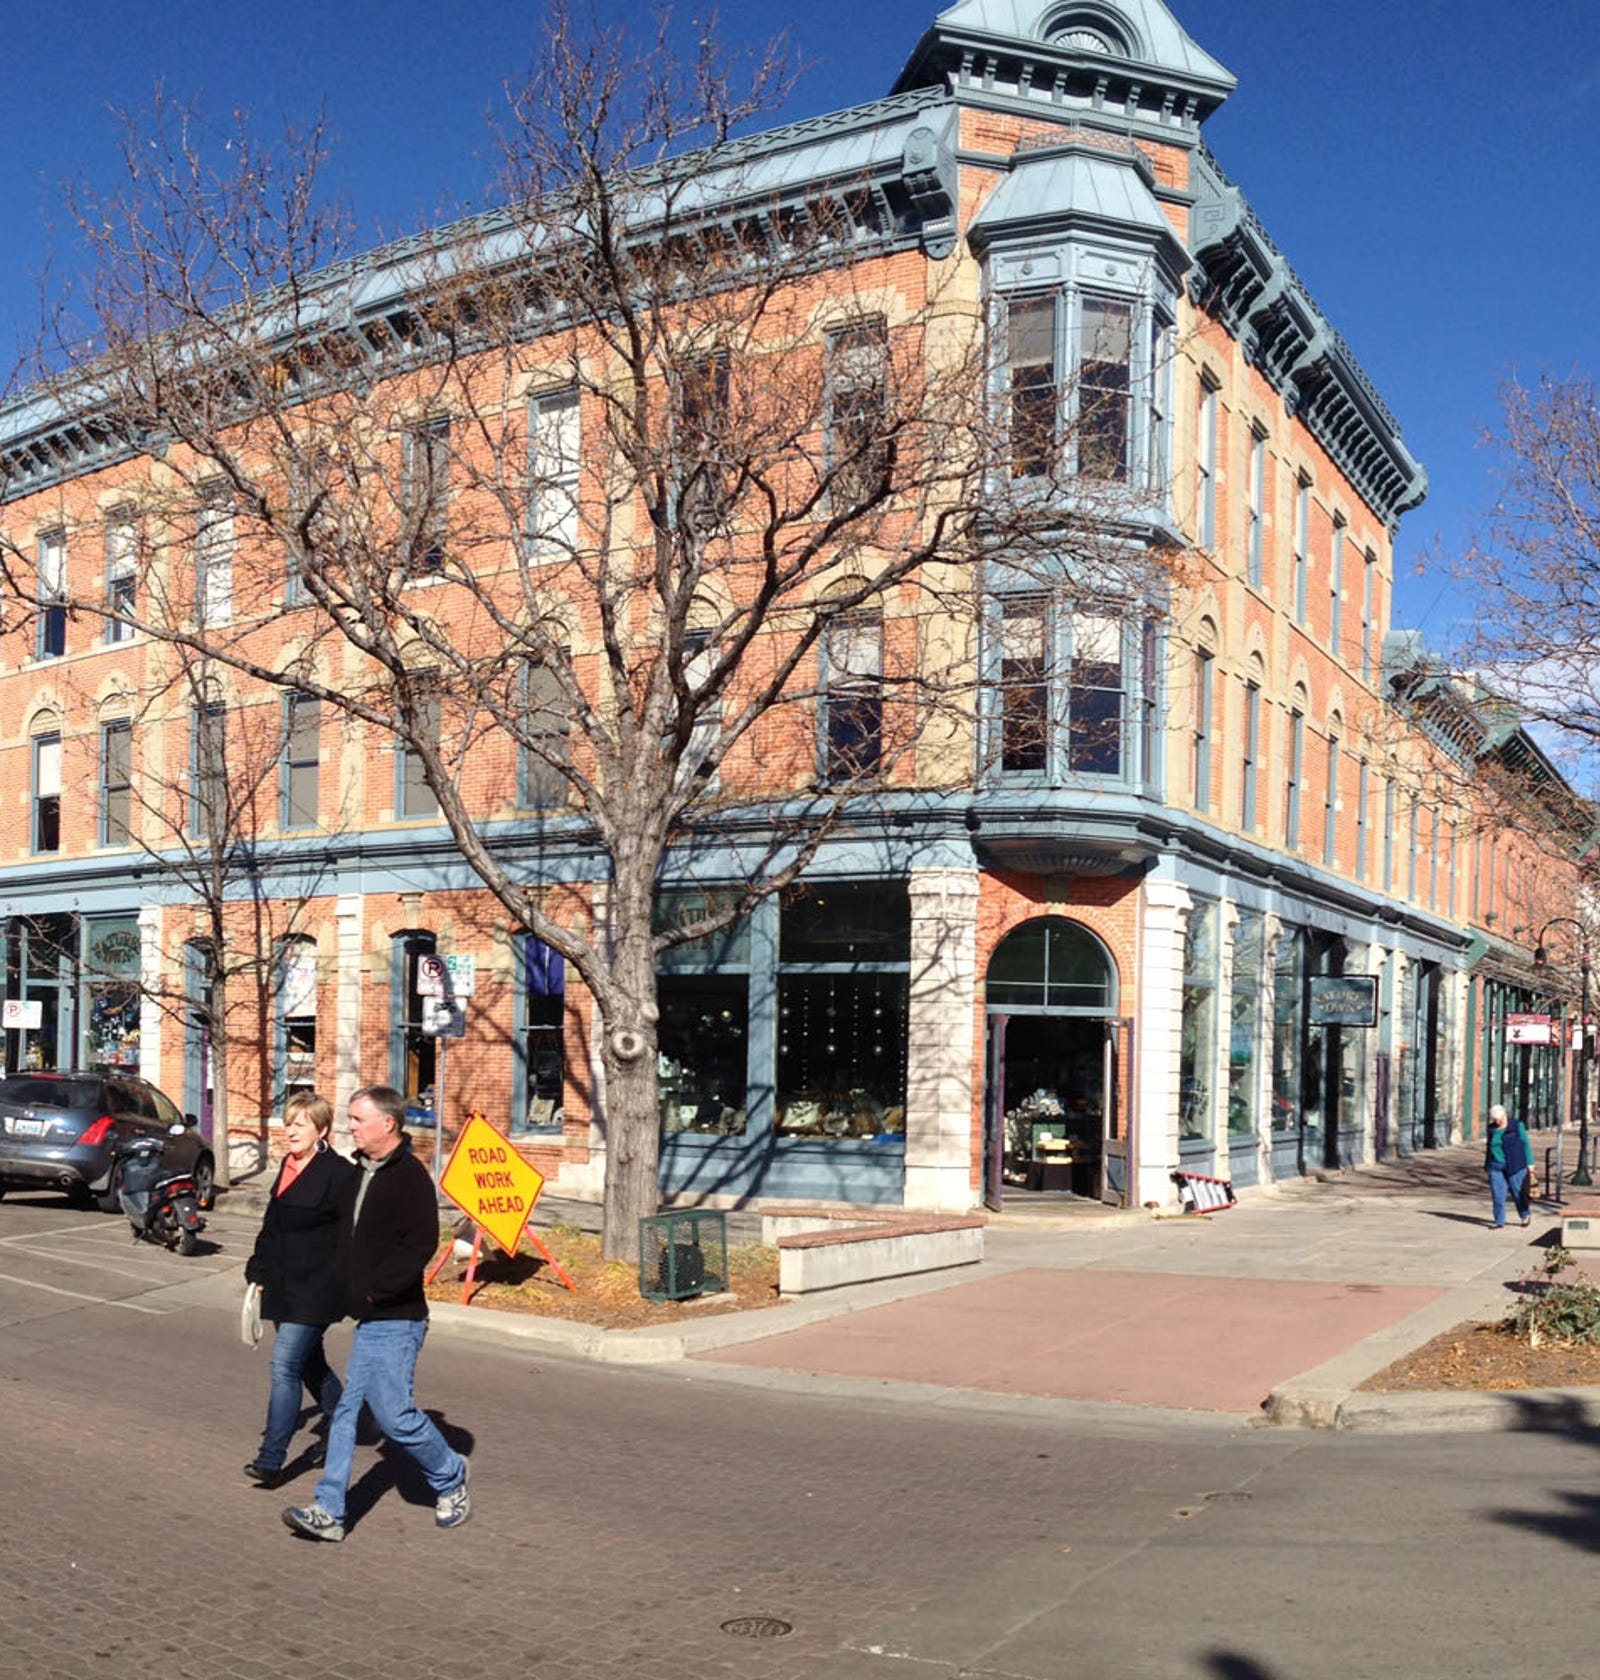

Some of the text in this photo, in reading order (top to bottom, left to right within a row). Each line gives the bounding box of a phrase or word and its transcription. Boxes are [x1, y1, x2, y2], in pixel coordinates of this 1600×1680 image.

[468, 1147, 507, 1164] ROAD
[474, 1171, 515, 1189] WORK
[478, 1195, 525, 1214] AHEAD
